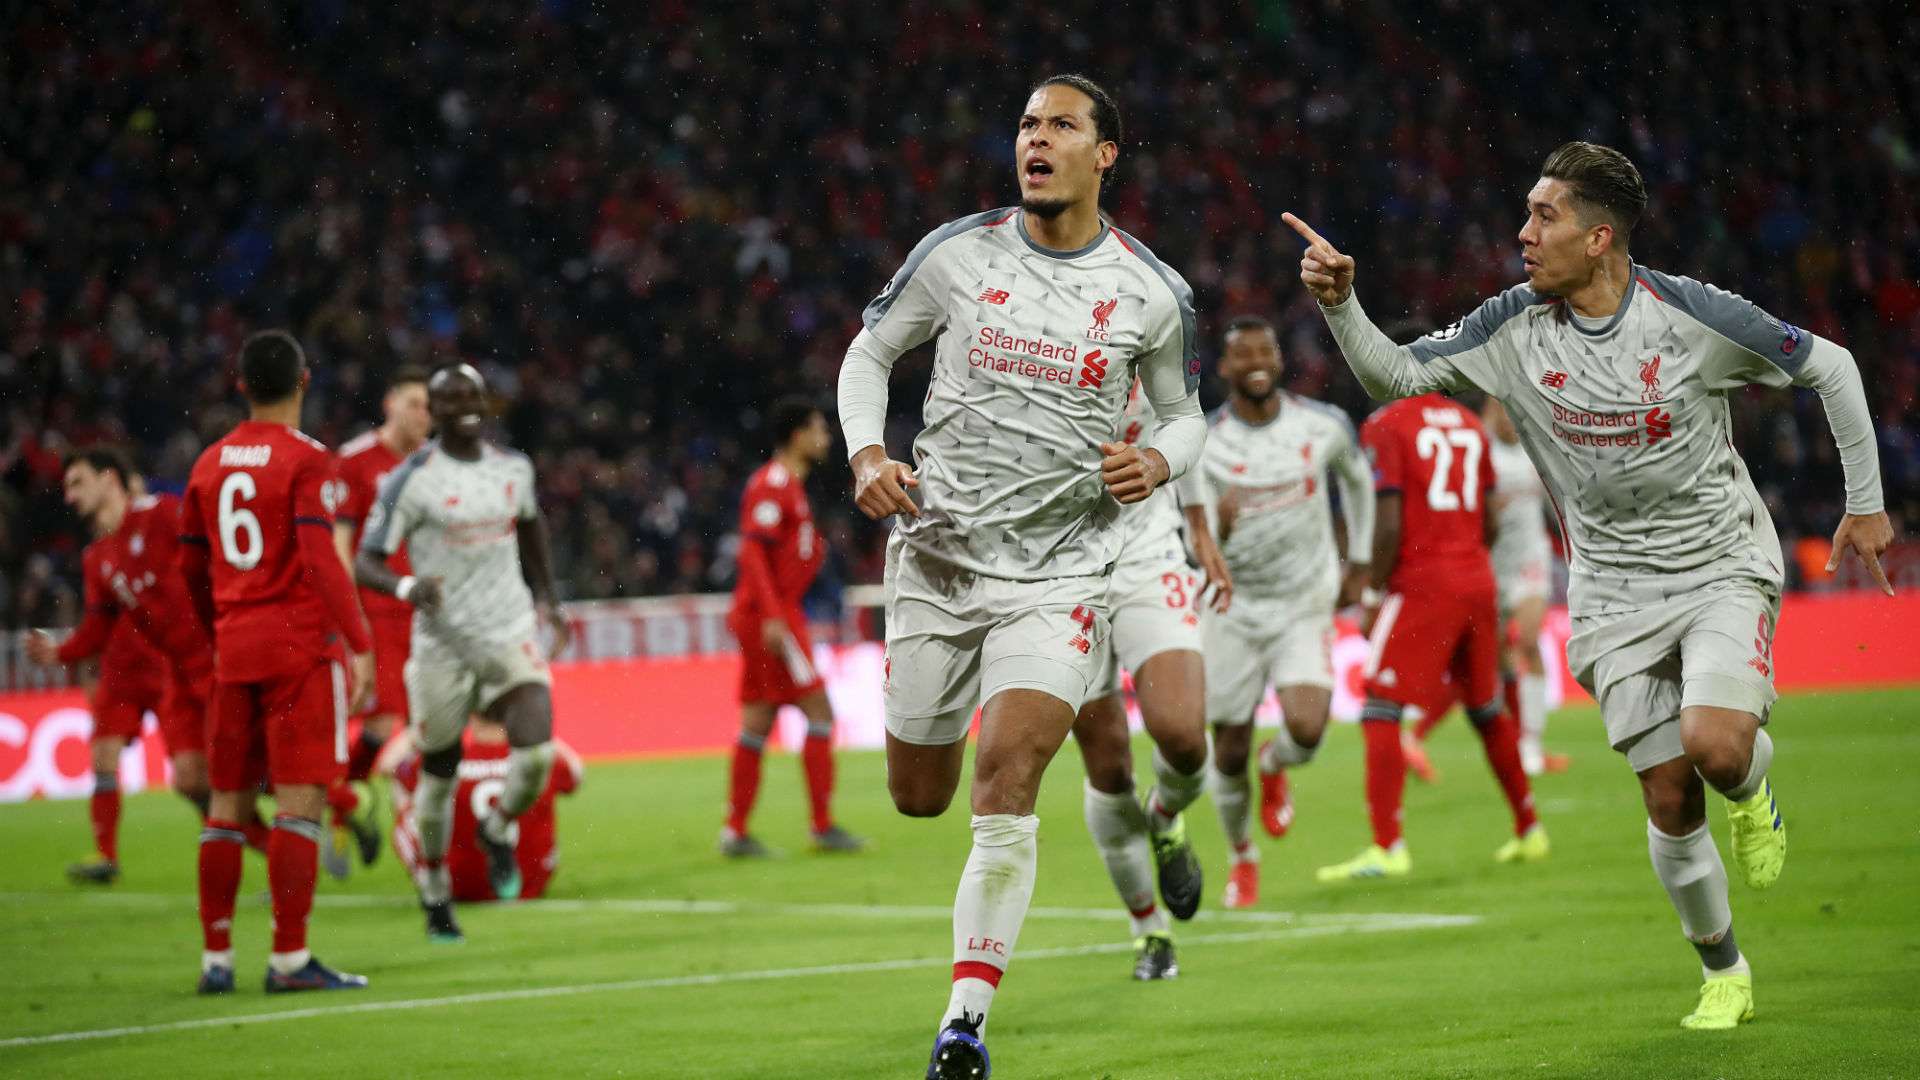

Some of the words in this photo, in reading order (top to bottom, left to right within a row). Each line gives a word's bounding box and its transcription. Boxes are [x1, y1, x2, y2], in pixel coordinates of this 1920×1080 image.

[978, 326, 1077, 363] Standard
[968, 348, 1074, 385] Chartered
[1552, 403, 1637, 427] Standard
[1551, 421, 1641, 447] Chartered
[1416, 427, 1482, 512] 27
[218, 471, 264, 571] 6
[1070, 604, 1096, 635] 4
[1755, 611, 1769, 660] 9
